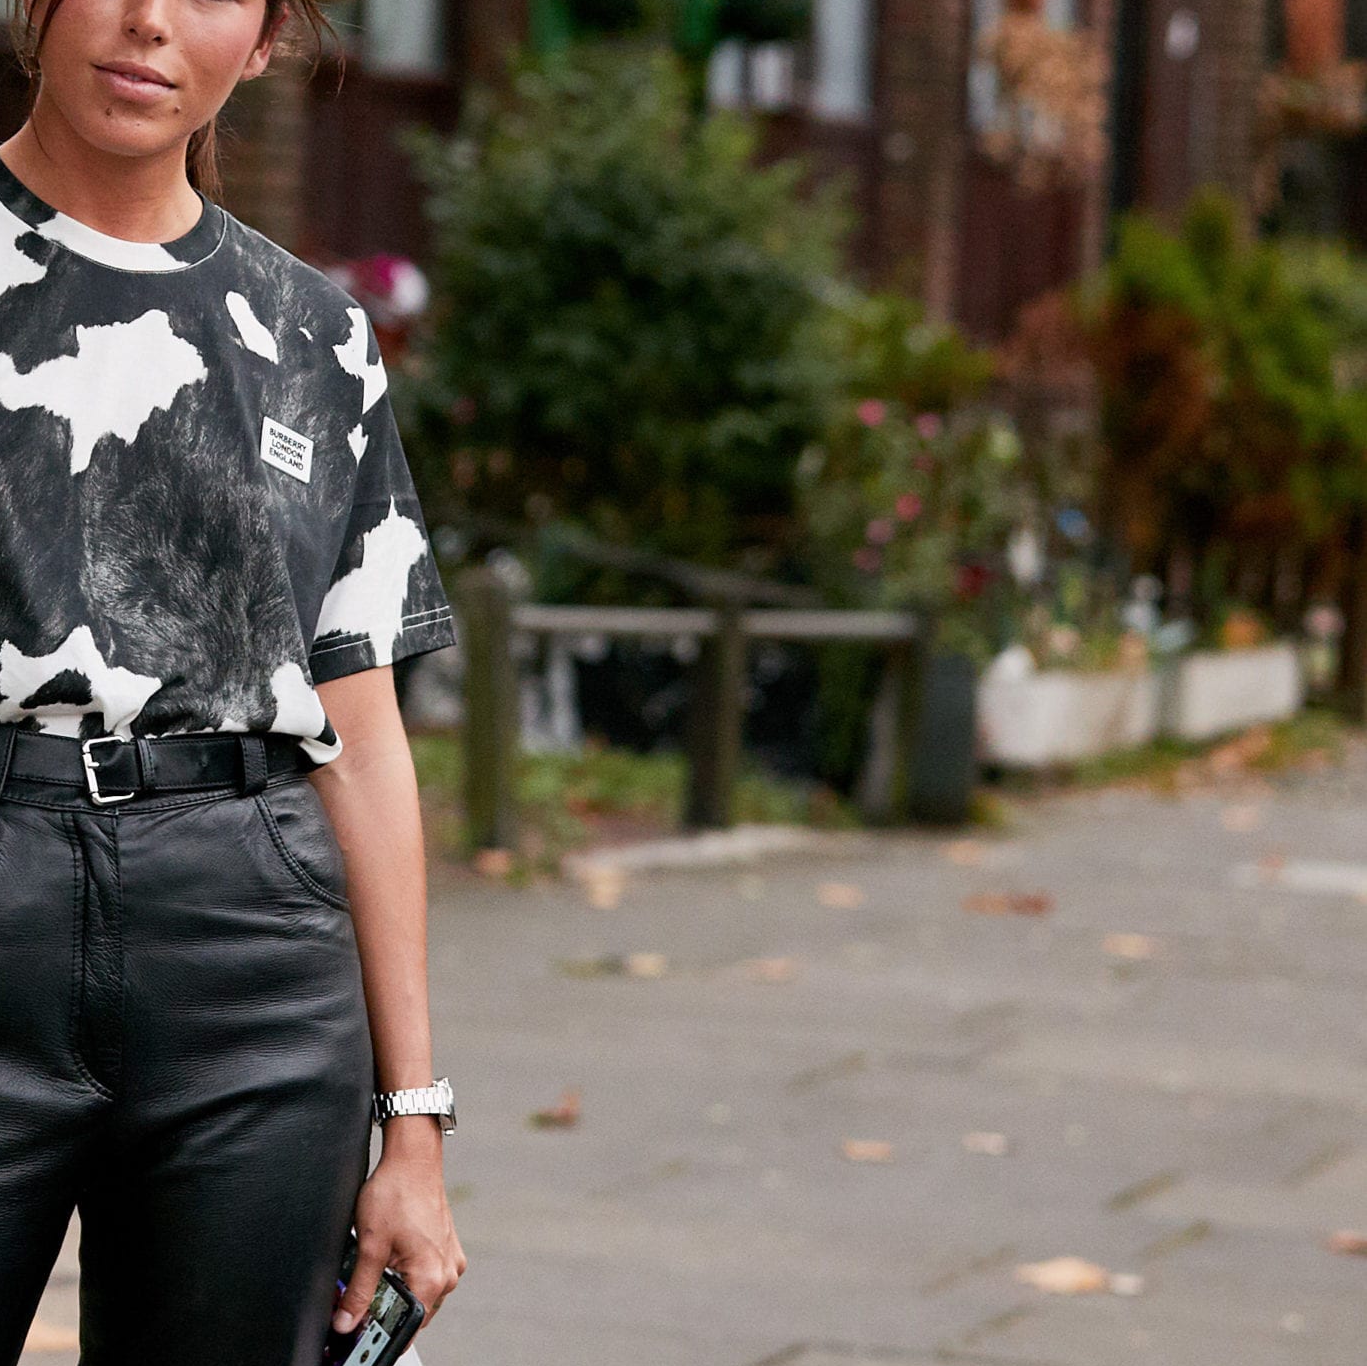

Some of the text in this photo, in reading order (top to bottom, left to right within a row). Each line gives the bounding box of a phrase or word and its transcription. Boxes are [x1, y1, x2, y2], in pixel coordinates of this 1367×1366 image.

[269, 427, 307, 453] BURBERRY
[271, 439, 303, 461] LONDON
[269, 447, 304, 470] ENGLAND
